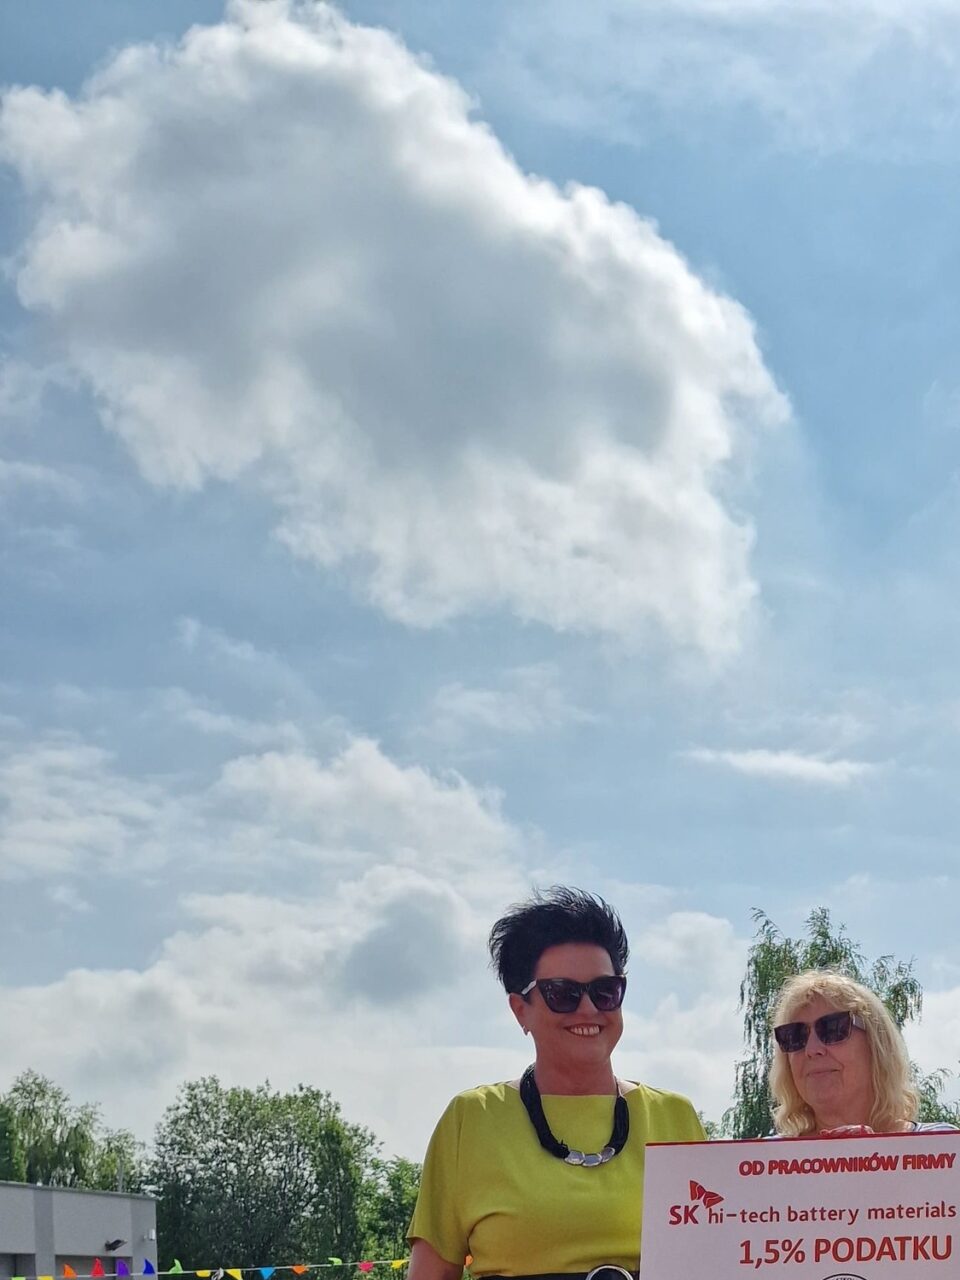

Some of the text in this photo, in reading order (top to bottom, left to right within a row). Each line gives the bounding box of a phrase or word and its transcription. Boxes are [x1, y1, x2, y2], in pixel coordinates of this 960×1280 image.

[738, 1152, 957, 1176] OD PRACOWNIKÓW FIRMY
[668, 1205, 699, 1225] SK
[708, 1206, 780, 1224] hi-tech
[787, 1206, 859, 1225] battery
[867, 1201, 957, 1219] materials
[739, 1235, 952, 1269] 1,5% PODATKU
